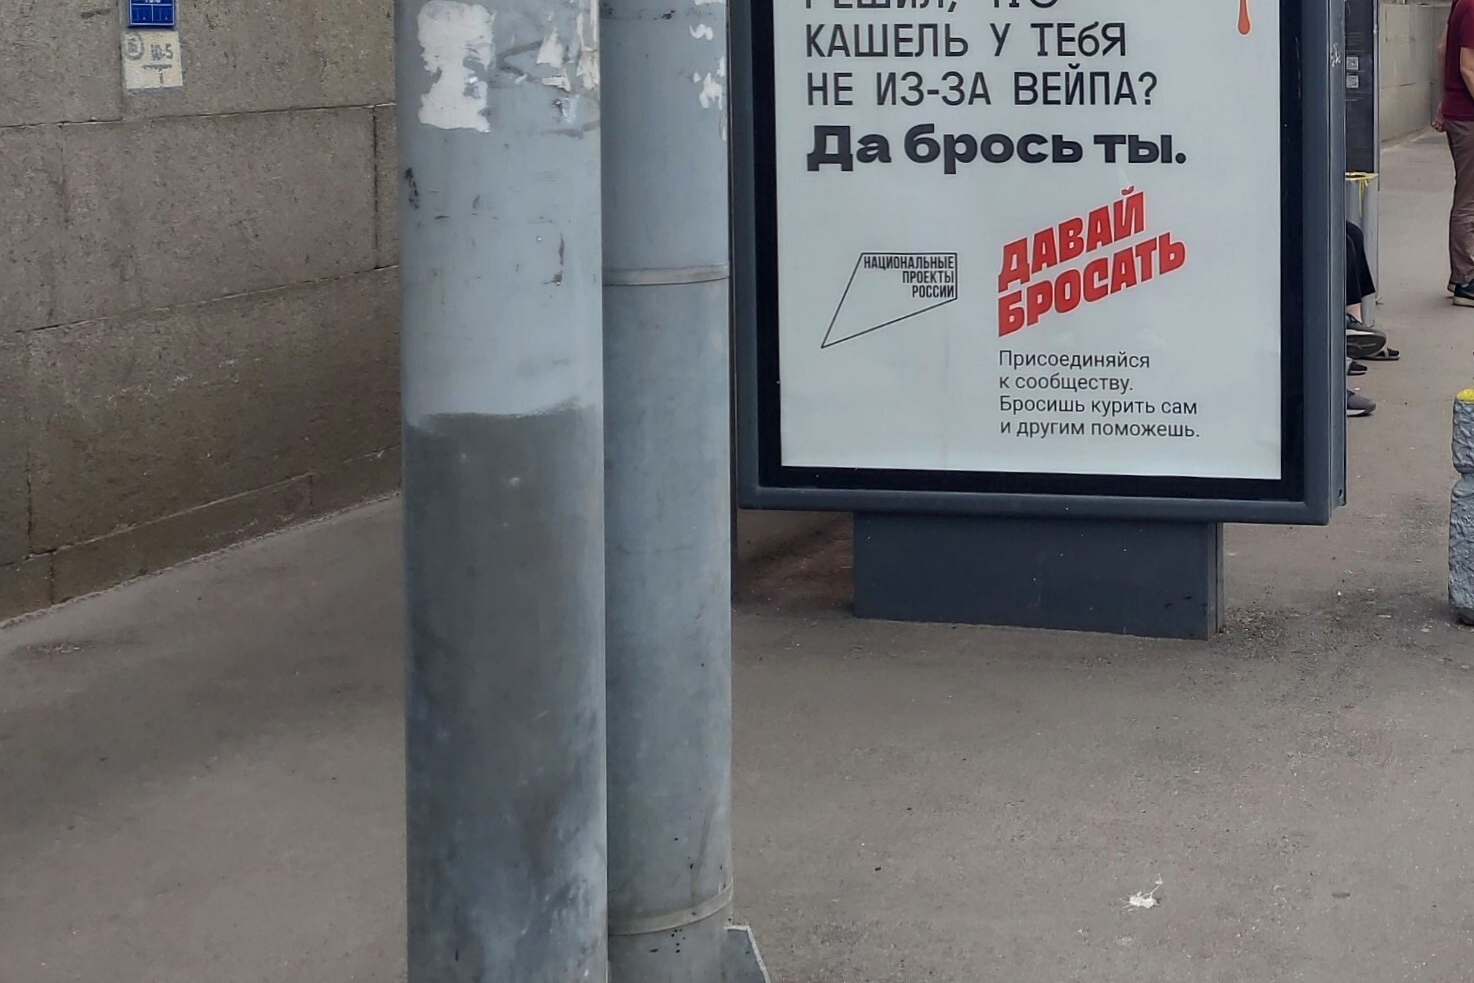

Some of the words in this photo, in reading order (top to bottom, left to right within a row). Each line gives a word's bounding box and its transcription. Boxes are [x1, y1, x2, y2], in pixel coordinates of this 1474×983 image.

[806, 24, 968, 57] КАШЕЛЬ
[990, 23, 1010, 56] У
[808, 73, 853, 105] НЕ
[877, 71, 991, 106] ИЗ-ЗА
[1014, 63, 1157, 105] ВЕЙПА?
[807, 125, 891, 171] Да
[904, 124, 1083, 174] брось
[1094, 135, 1186, 164] ты.
[999, 185, 1146, 293] ДАВАЙ
[864, 256, 954, 270] НАЦИОНАЛЬНЫЕ
[902, 271, 954, 283] ПРОЕКТЫ
[999, 231, 1187, 337] БРОСАТЬ
[911, 285, 954, 298] РОССИИ
[1000, 350, 1149, 370] Присоединяйся
[1000, 377, 1009, 388] к
[1016, 373, 1133, 394] сообществу.
[1000, 396, 1085, 415] Бросишь
[1092, 401, 1155, 417] курить
[1162, 402, 1196, 414] сам
[1001, 422, 1010, 433] и
[1017, 422, 1084, 438] другим
[1092, 423, 1199, 437] поможешь.
